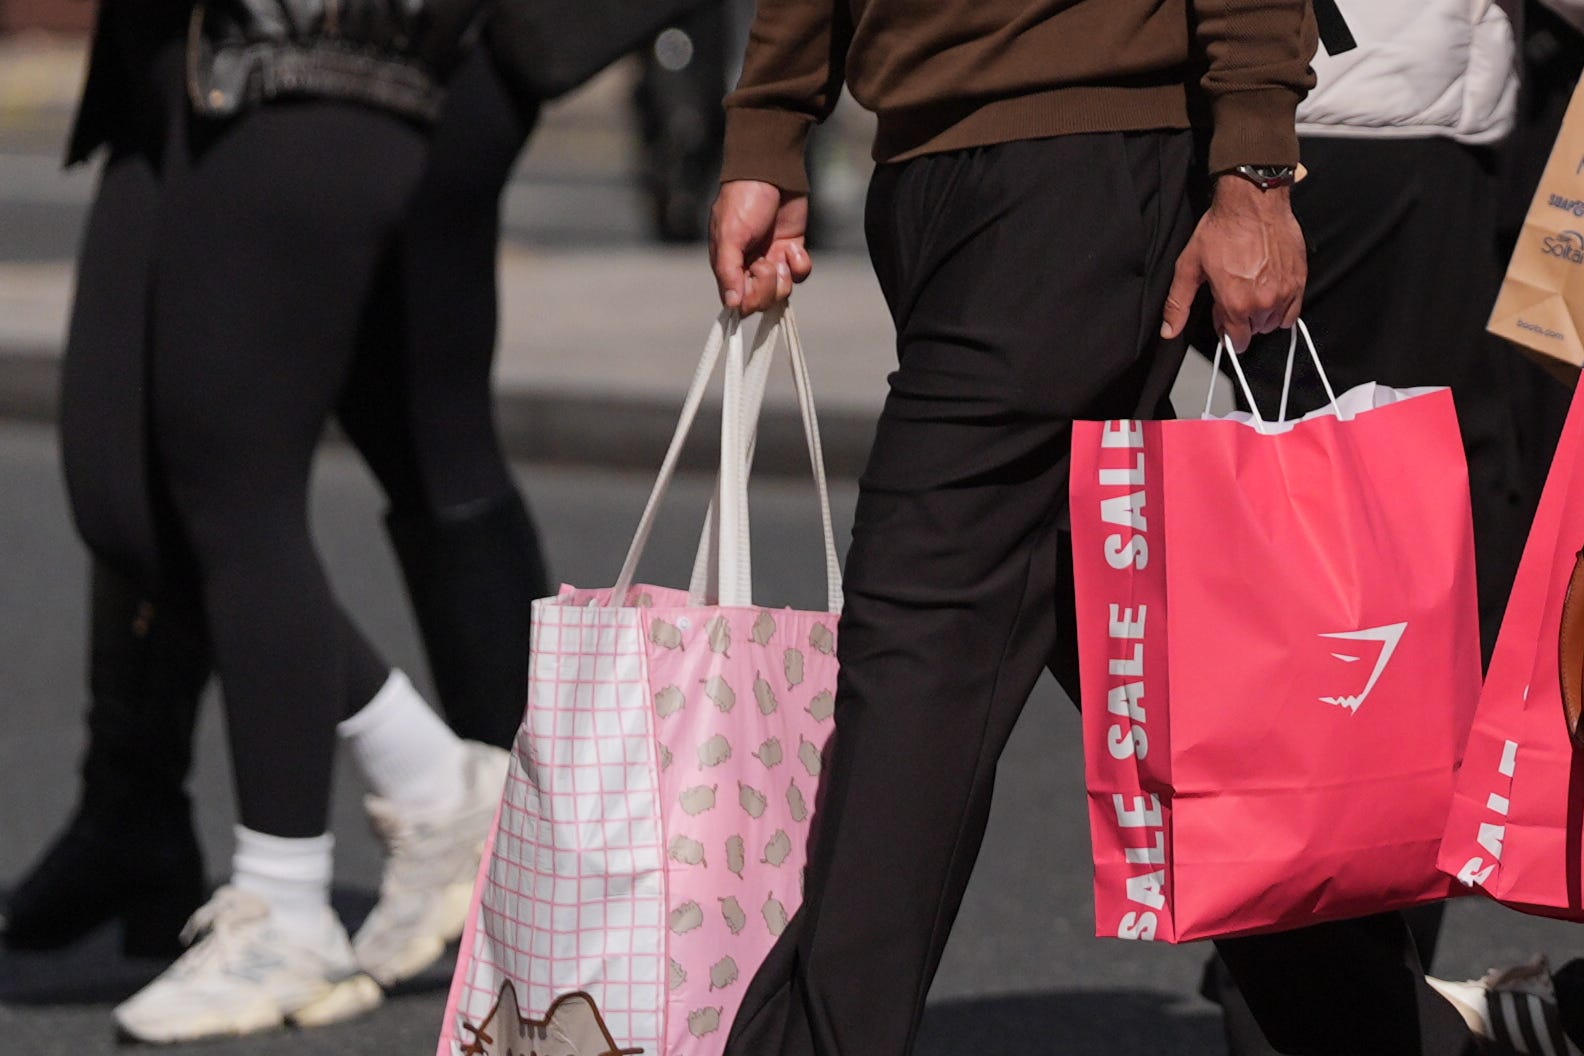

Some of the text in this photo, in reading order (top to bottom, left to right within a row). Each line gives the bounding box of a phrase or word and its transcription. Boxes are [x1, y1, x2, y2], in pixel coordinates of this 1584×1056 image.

[1099, 419, 1166, 942] SALE SALE SALE
